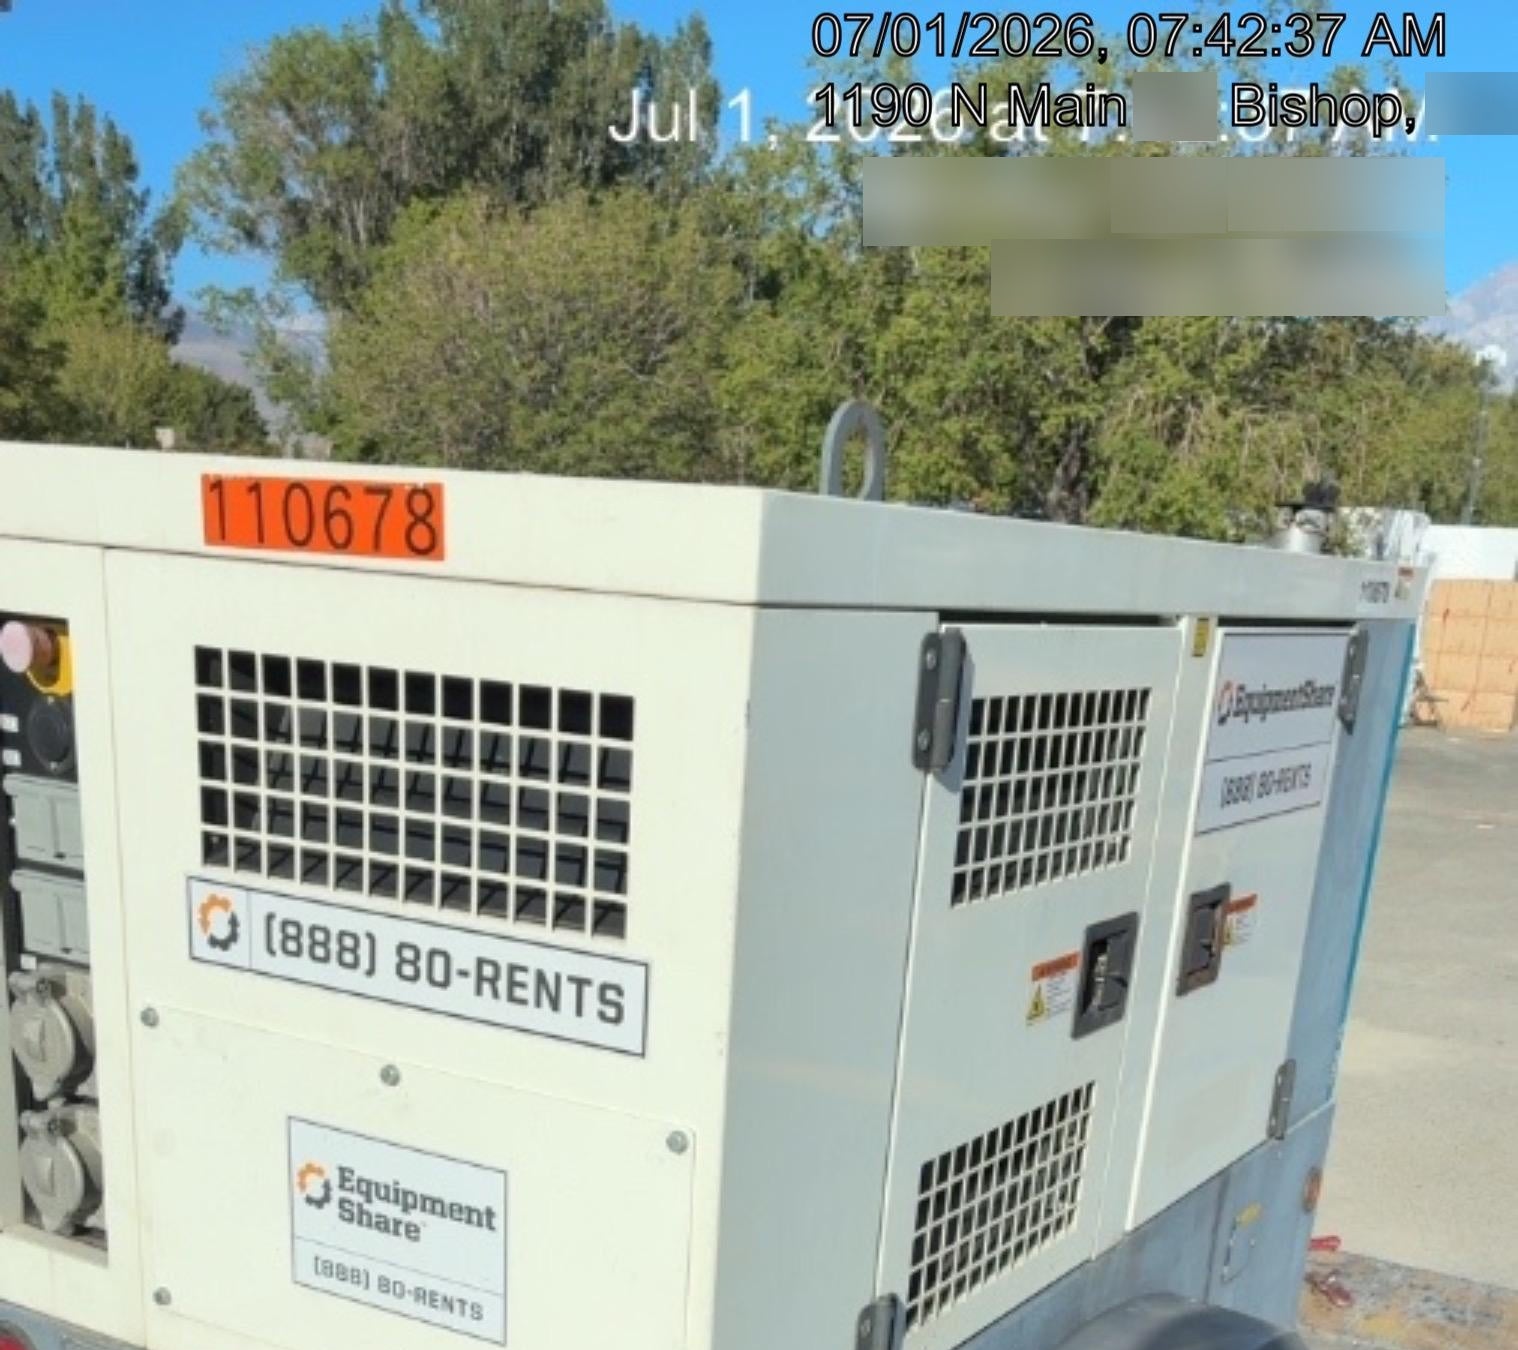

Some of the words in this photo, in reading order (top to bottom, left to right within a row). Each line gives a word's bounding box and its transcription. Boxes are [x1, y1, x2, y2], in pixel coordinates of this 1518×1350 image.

[208, 479, 438, 556] 110678
[265, 911, 377, 978] (888)
[394, 941, 626, 1026] 80-RENTS
[337, 1164, 497, 1232] Equipment
[338, 1196, 422, 1243] Share
[313, 1255, 370, 1291] (888)
[377, 1274, 485, 1322] 80-RENTS
